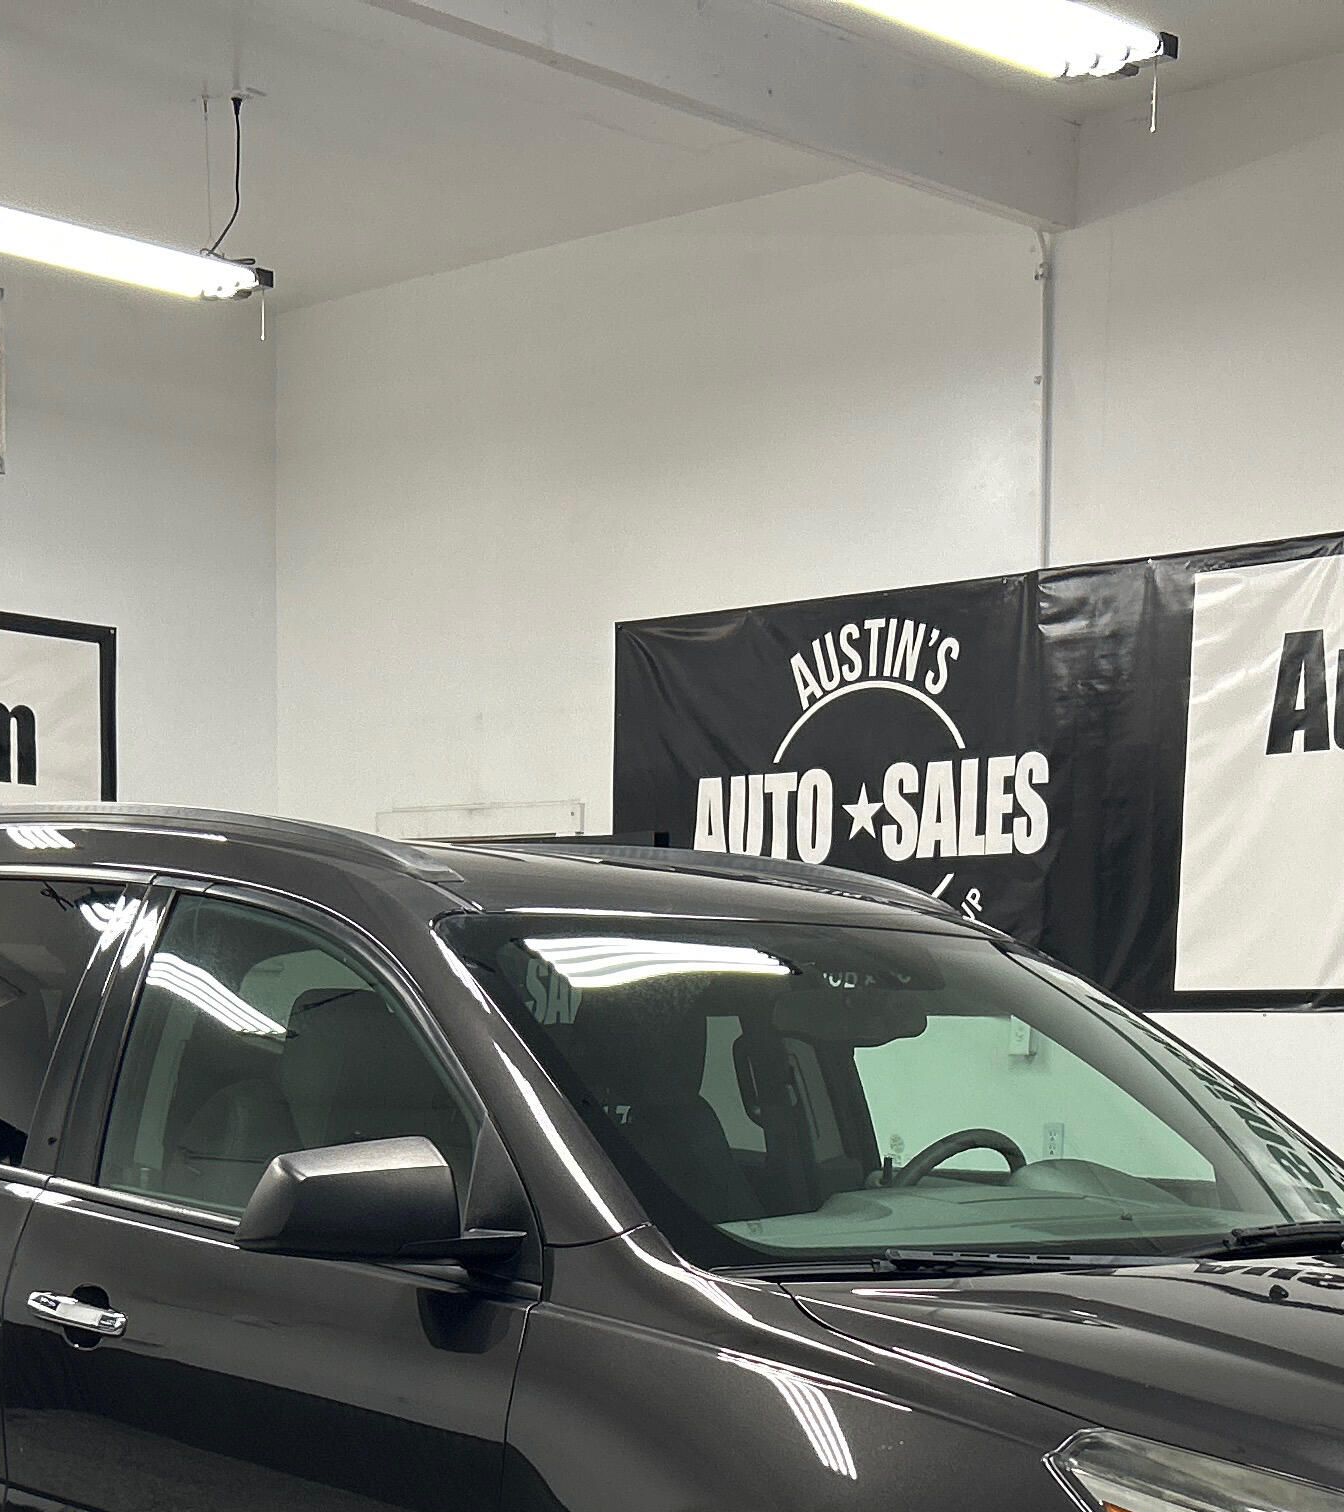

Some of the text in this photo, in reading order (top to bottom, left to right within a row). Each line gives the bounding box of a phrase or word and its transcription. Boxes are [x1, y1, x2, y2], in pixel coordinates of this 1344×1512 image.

[789, 617, 960, 711] AUSTIN'S
[693, 750, 1050, 865] AUTO SALES
